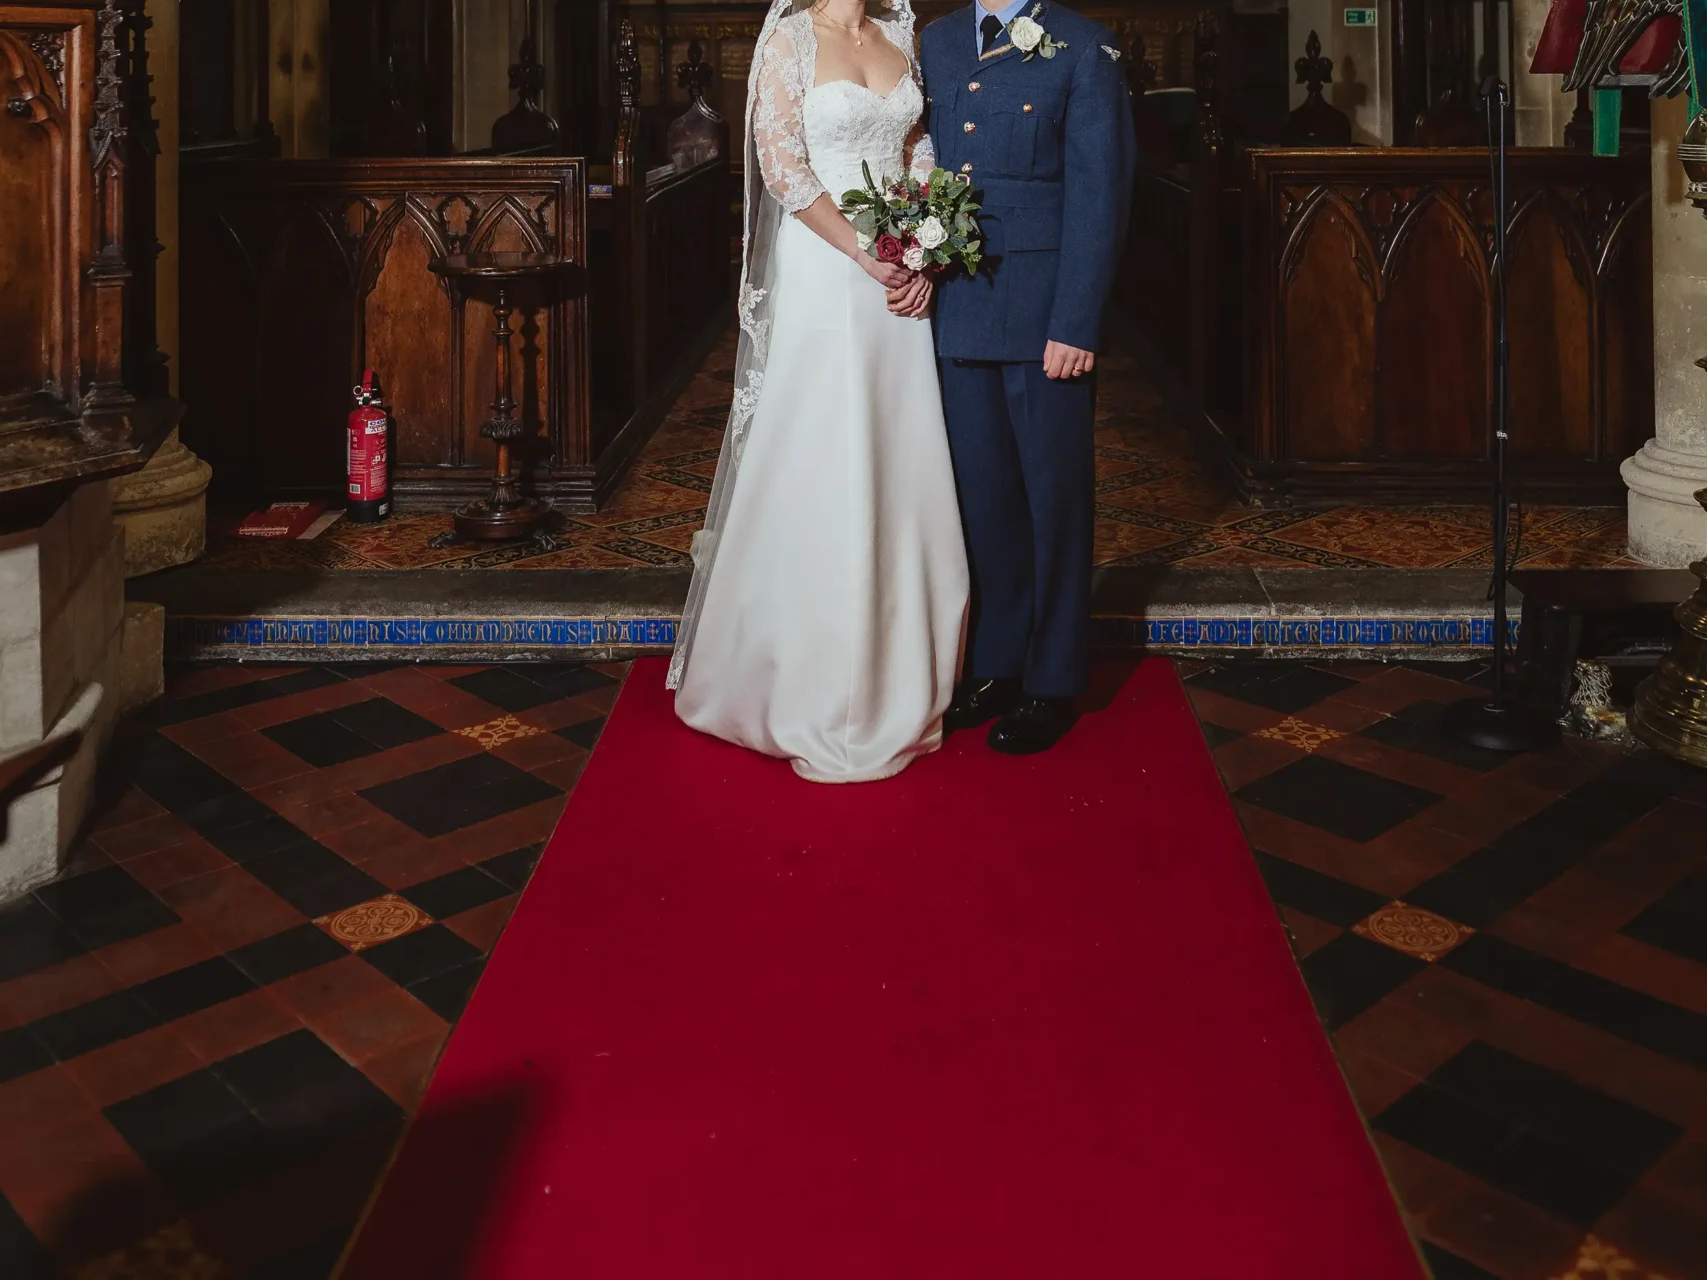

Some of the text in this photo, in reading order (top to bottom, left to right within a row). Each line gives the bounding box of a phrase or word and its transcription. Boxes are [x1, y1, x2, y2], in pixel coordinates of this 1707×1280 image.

[264, 623, 315, 641] THAT
[329, 623, 352, 641] DO
[422, 622, 579, 642] COMMANDMENTS
[593, 622, 645, 641] THAT
[1253, 622, 1321, 642] ENTER
[1337, 622, 1360, 642] IN
[1376, 622, 1471, 642] THROUGH
